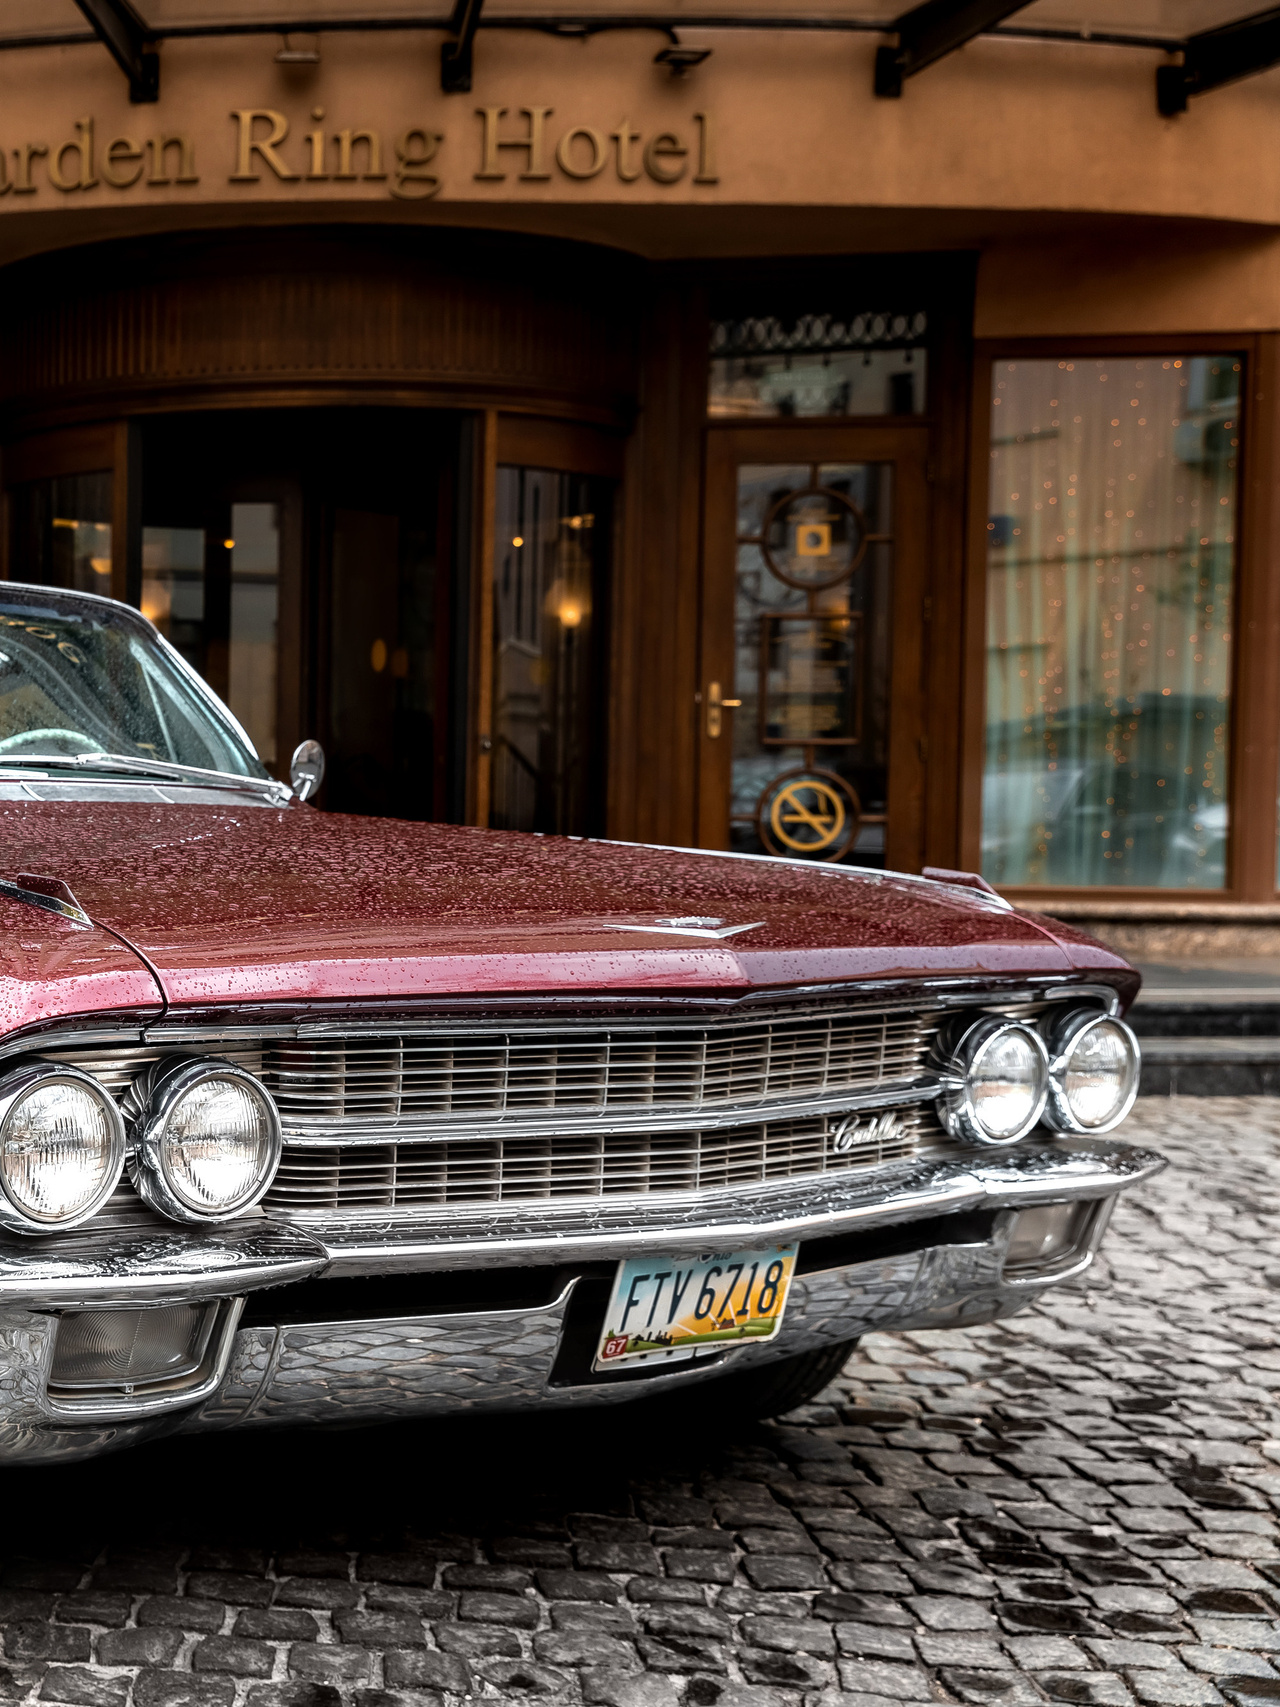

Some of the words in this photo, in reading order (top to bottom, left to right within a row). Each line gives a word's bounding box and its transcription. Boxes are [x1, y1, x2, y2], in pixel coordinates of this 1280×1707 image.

[228, 107, 444, 200] Ring
[472, 106, 720, 186] Hotel
[619, 1269, 694, 1332] FTV
[694, 1259, 784, 1320] 6718
[606, 1339, 627, 1355] 67
